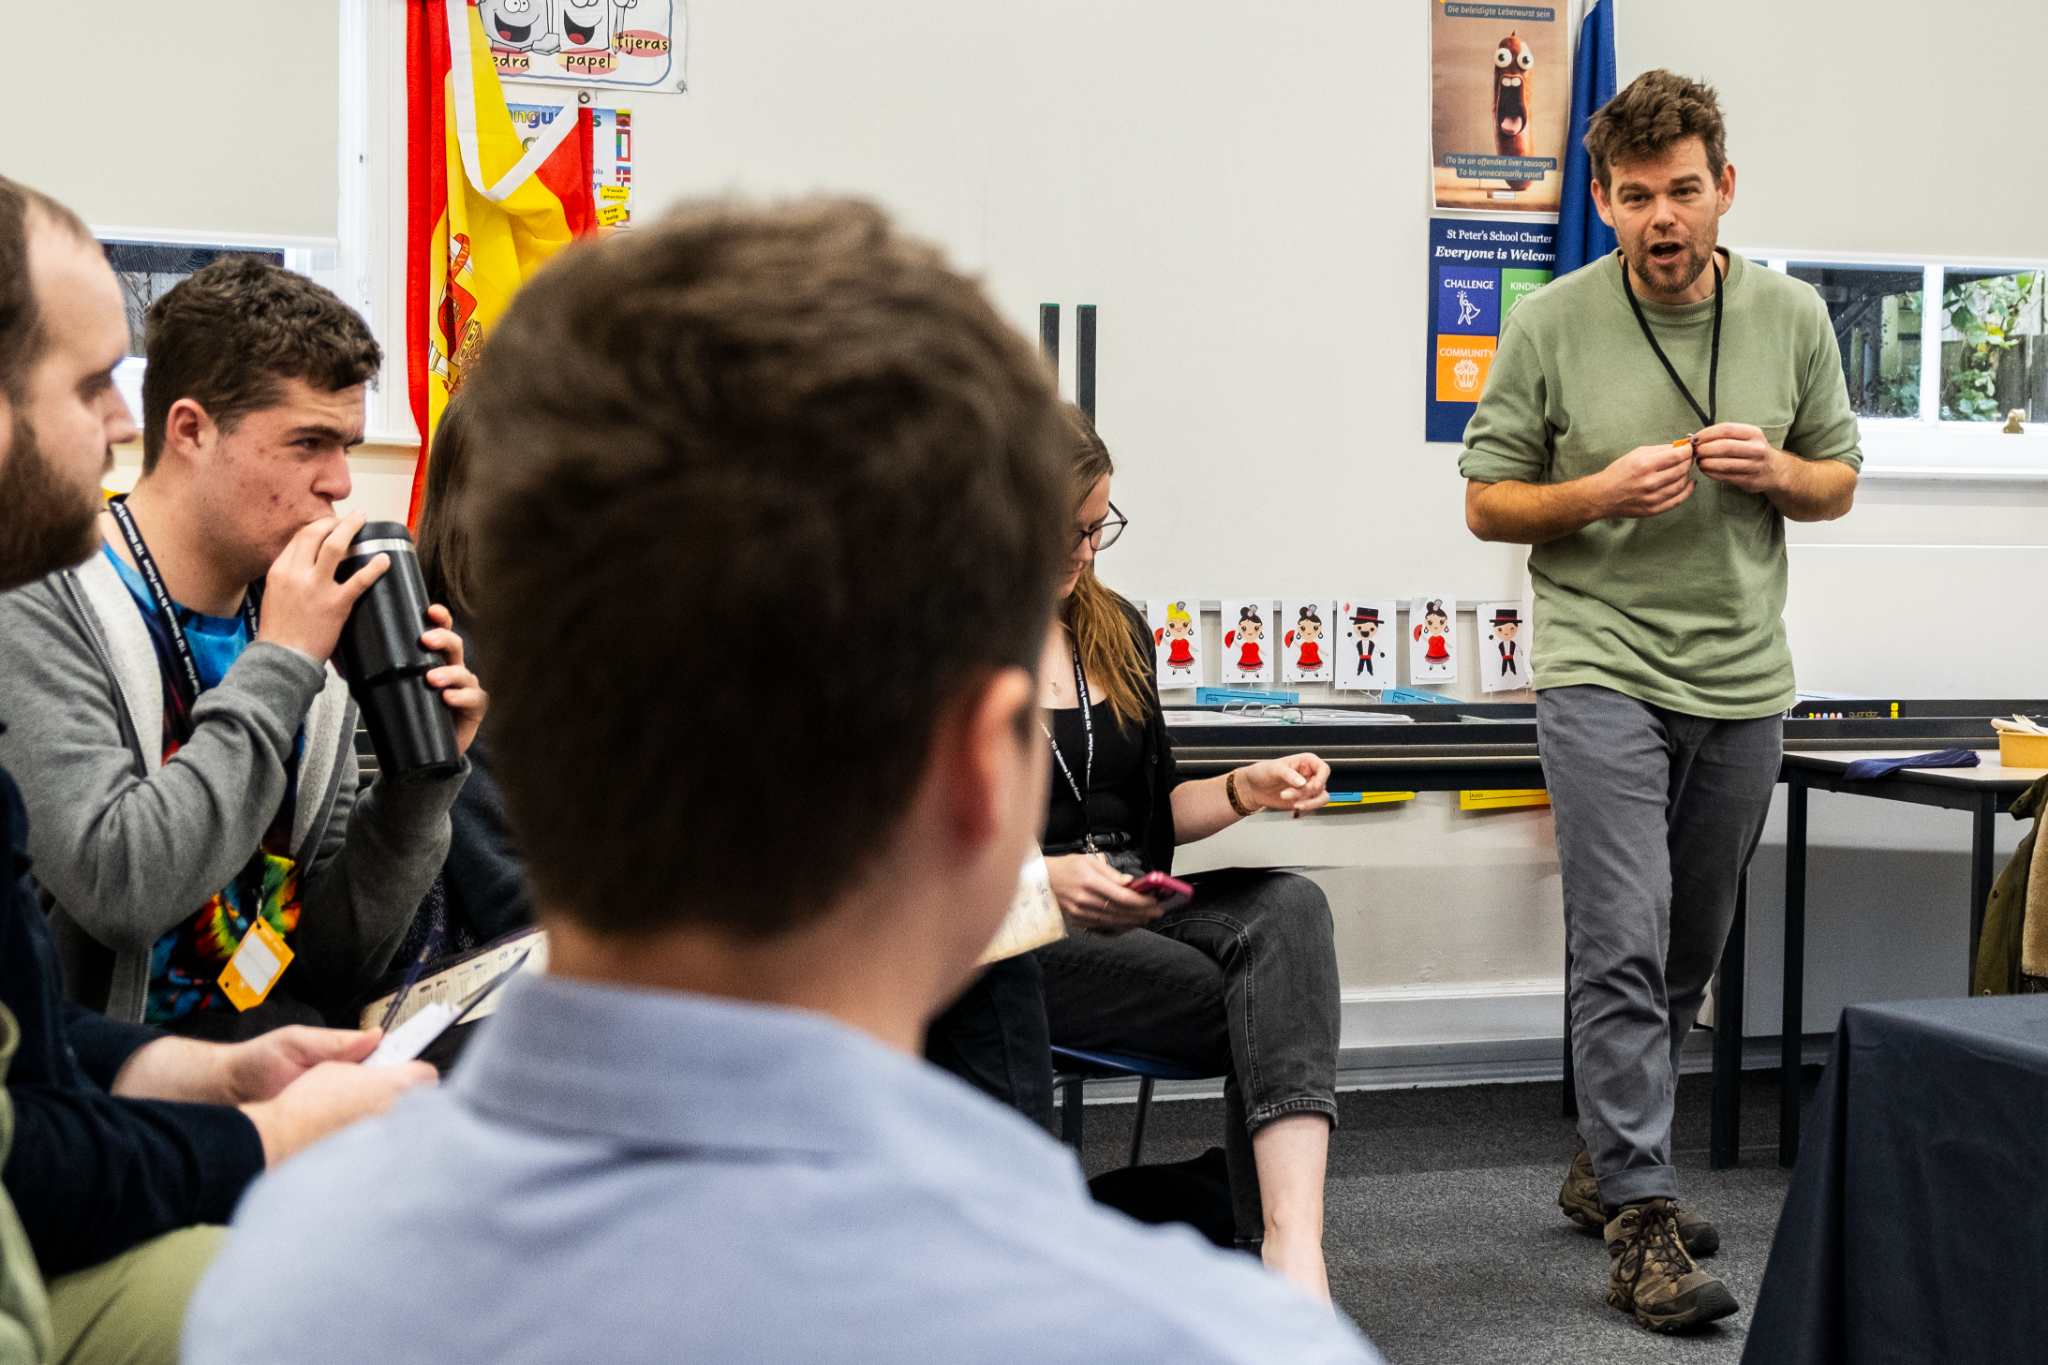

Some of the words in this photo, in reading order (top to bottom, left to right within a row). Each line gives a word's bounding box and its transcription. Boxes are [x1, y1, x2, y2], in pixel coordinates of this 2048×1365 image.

[616, 33, 668, 55] tijeras
[492, 52, 529, 68] edra
[566, 52, 610, 73] papel
[1447, 229, 1456, 239] St
[1489, 231, 1519, 242] School
[1520, 232, 1553, 244] Charter
[1435, 245, 1494, 261] Everyone
[1497, 248, 1507, 260] is
[1510, 249, 1556, 262] Welcom
[1444, 279, 1494, 290] CHALLENGE
[1440, 348, 1494, 358] COMMUNITY
